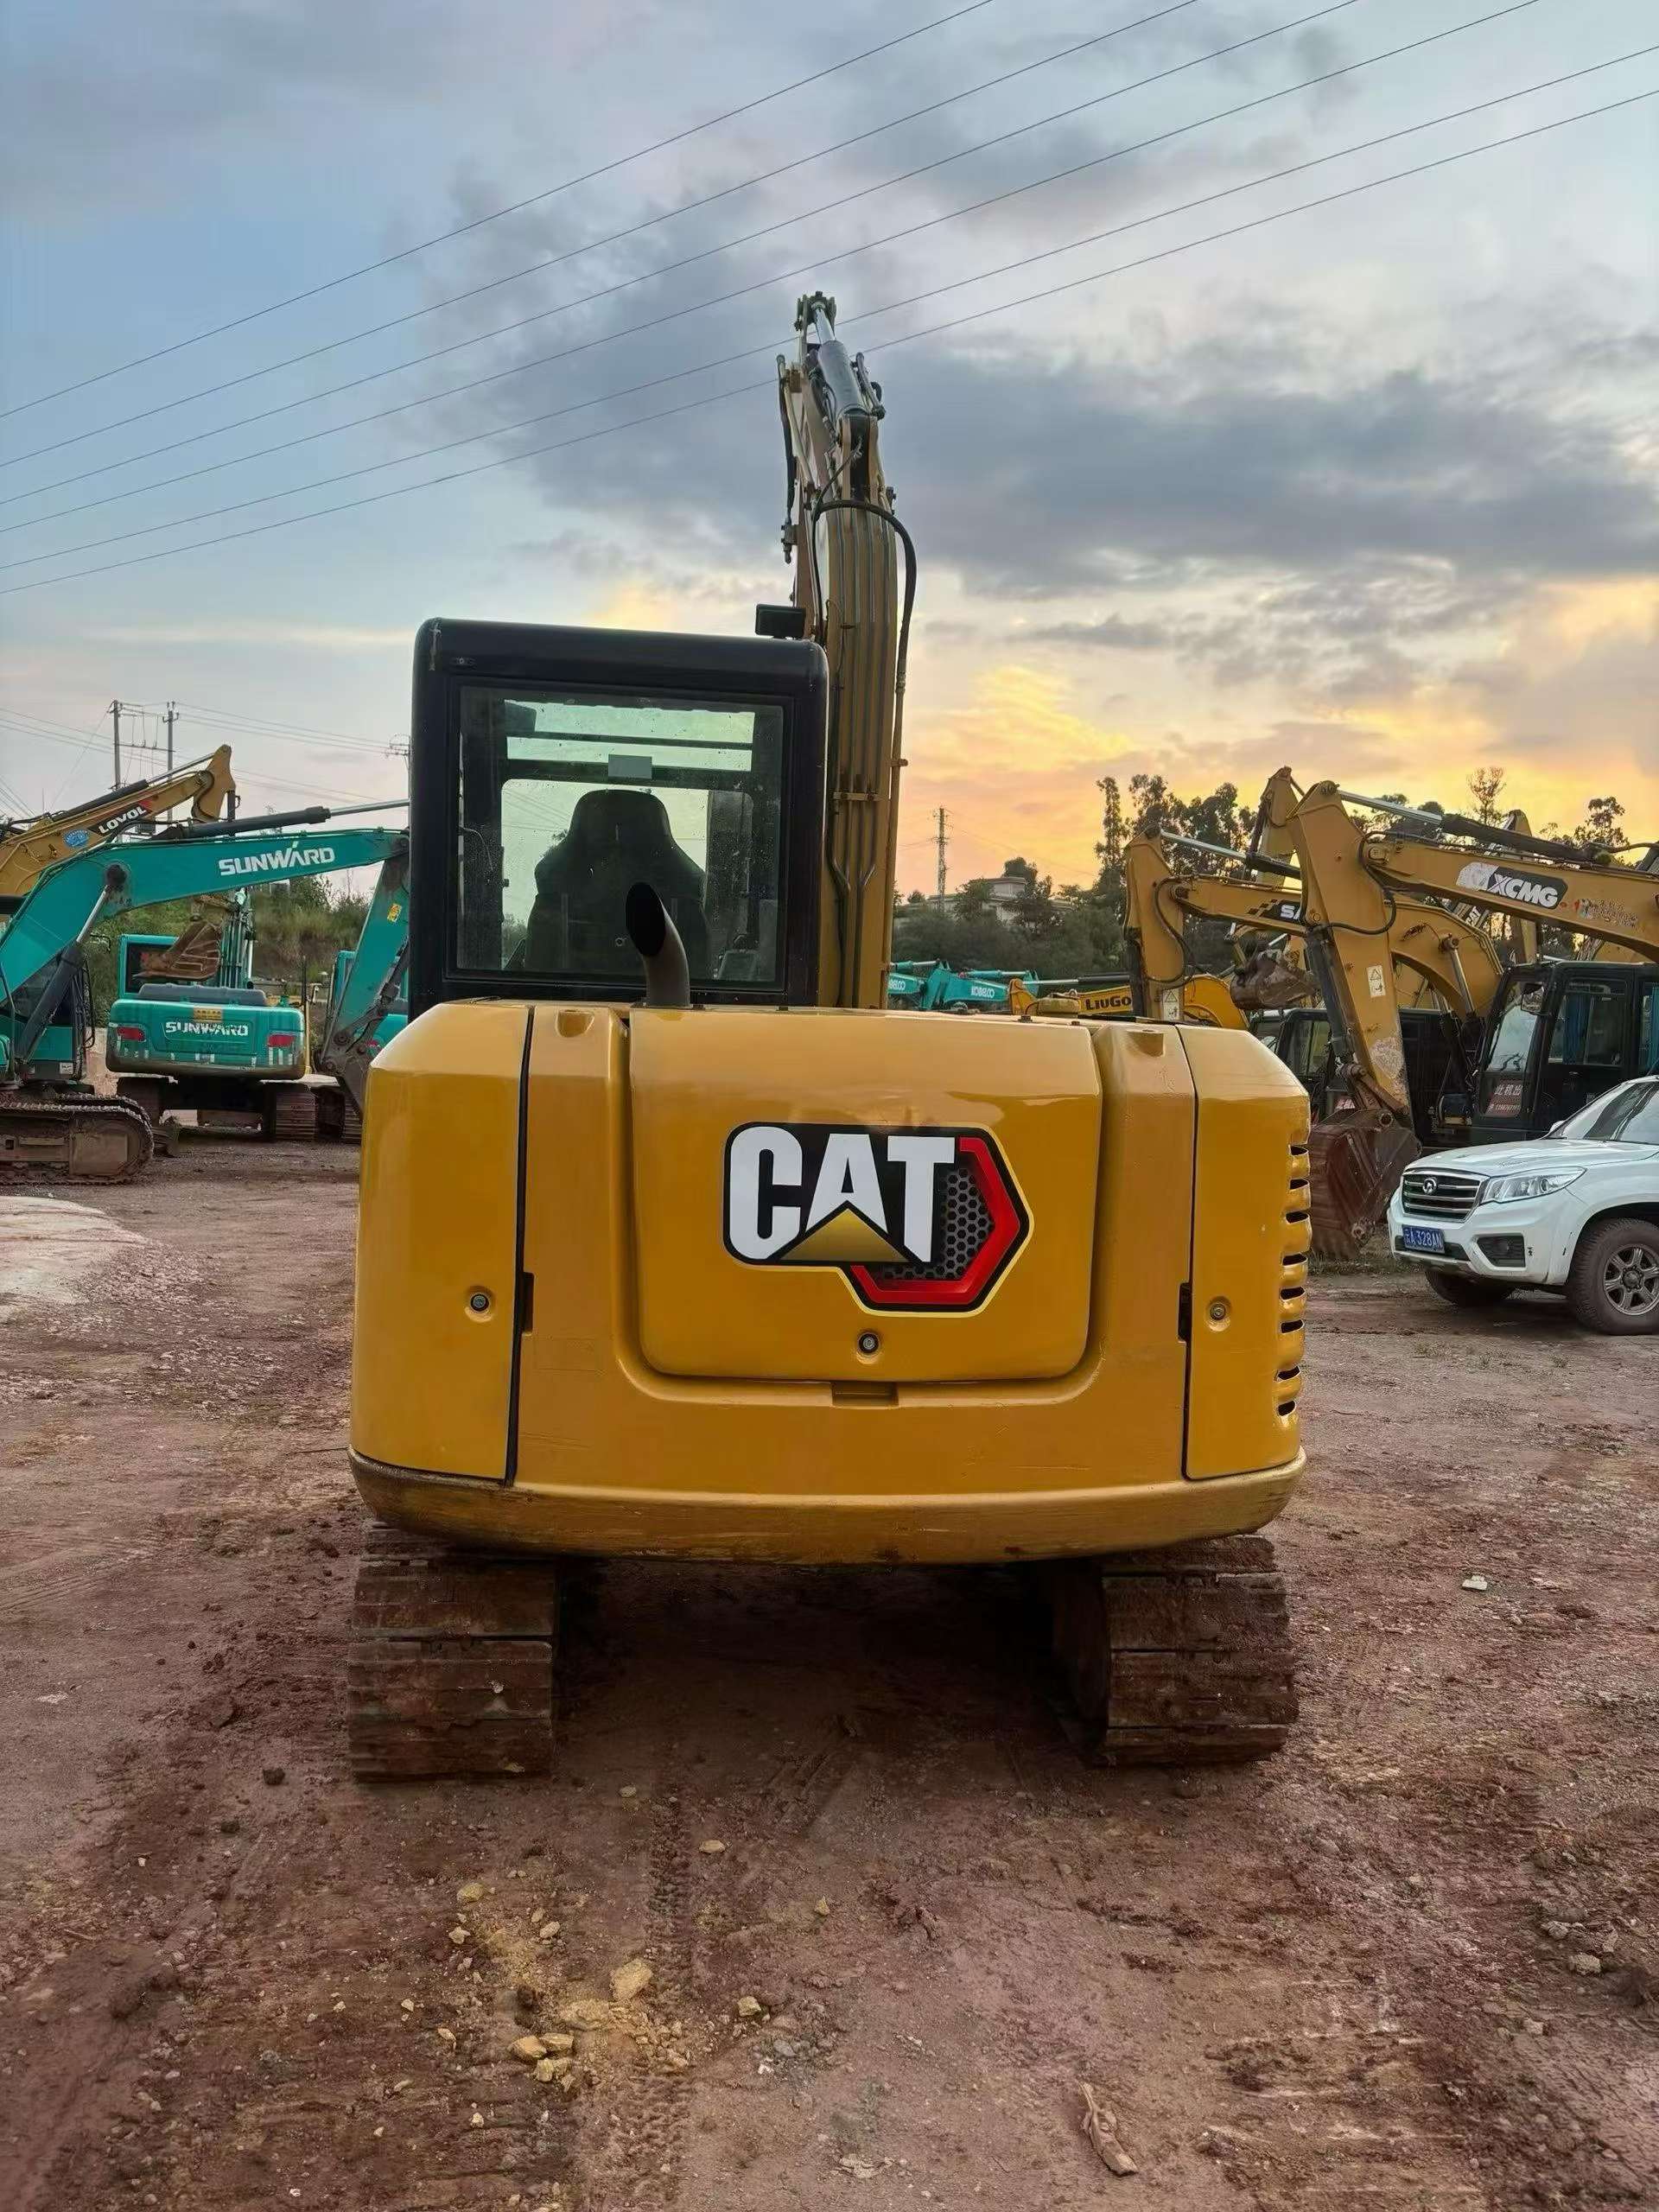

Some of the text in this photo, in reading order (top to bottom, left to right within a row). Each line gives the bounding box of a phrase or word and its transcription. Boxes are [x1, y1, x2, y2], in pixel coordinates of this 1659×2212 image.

[99, 805, 147, 834] LOVOL
[218, 842, 335, 876] SUNWARD
[1487, 874, 1559, 908] XCMG
[165, 1021, 249, 1037] SUNWARD
[729, 1126, 955, 1262] CAT
